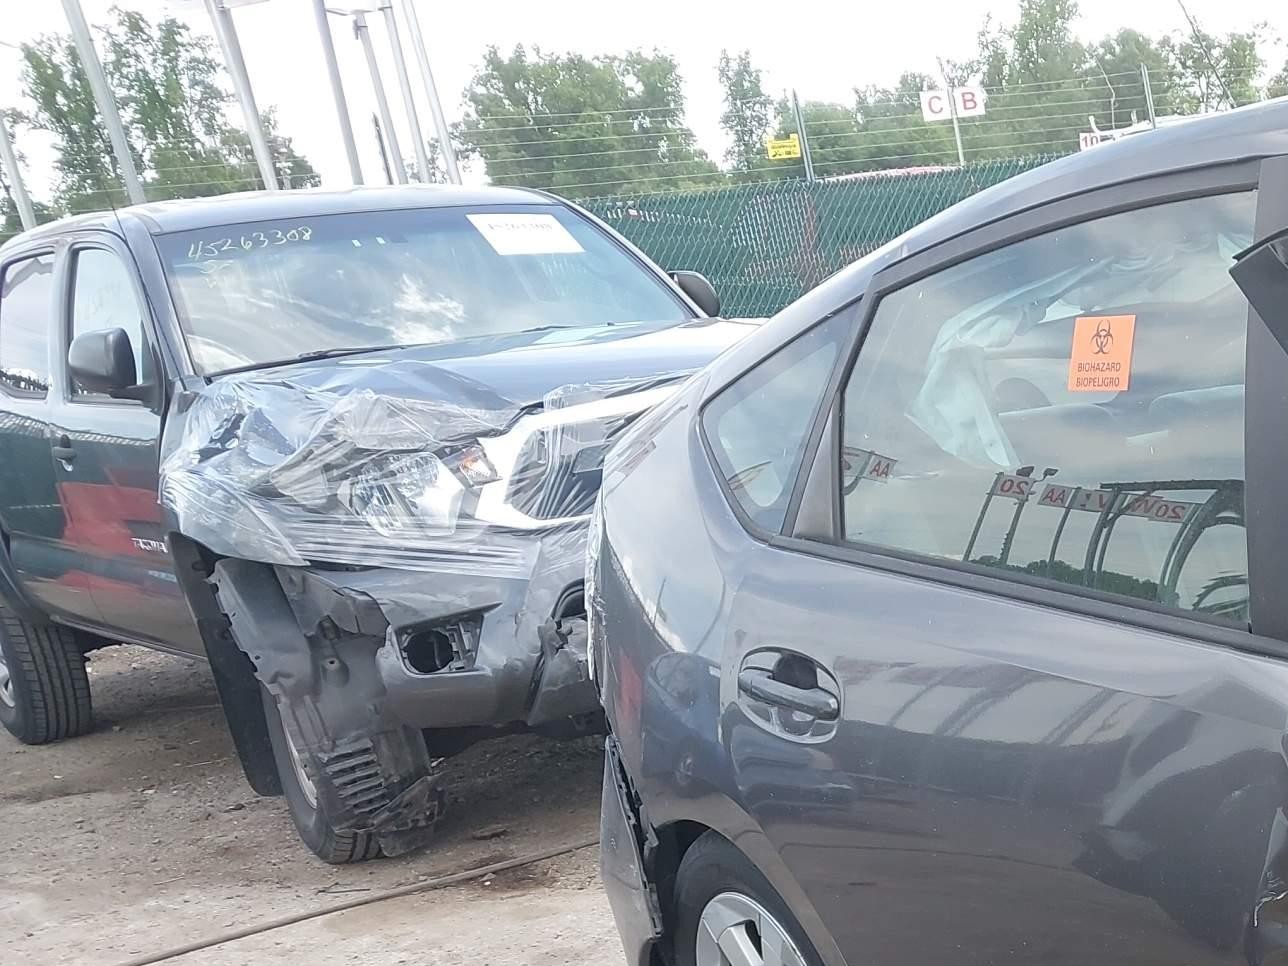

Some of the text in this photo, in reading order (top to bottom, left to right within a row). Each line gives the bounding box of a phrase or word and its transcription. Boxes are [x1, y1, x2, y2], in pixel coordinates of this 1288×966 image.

[928, 95, 944, 114] C
[961, 91, 977, 110] B
[187, 226, 313, 261] 45263308
[1077, 362, 1121, 373] BIOHAZARD
[1075, 376, 1120, 387] BIOPELIGRO
